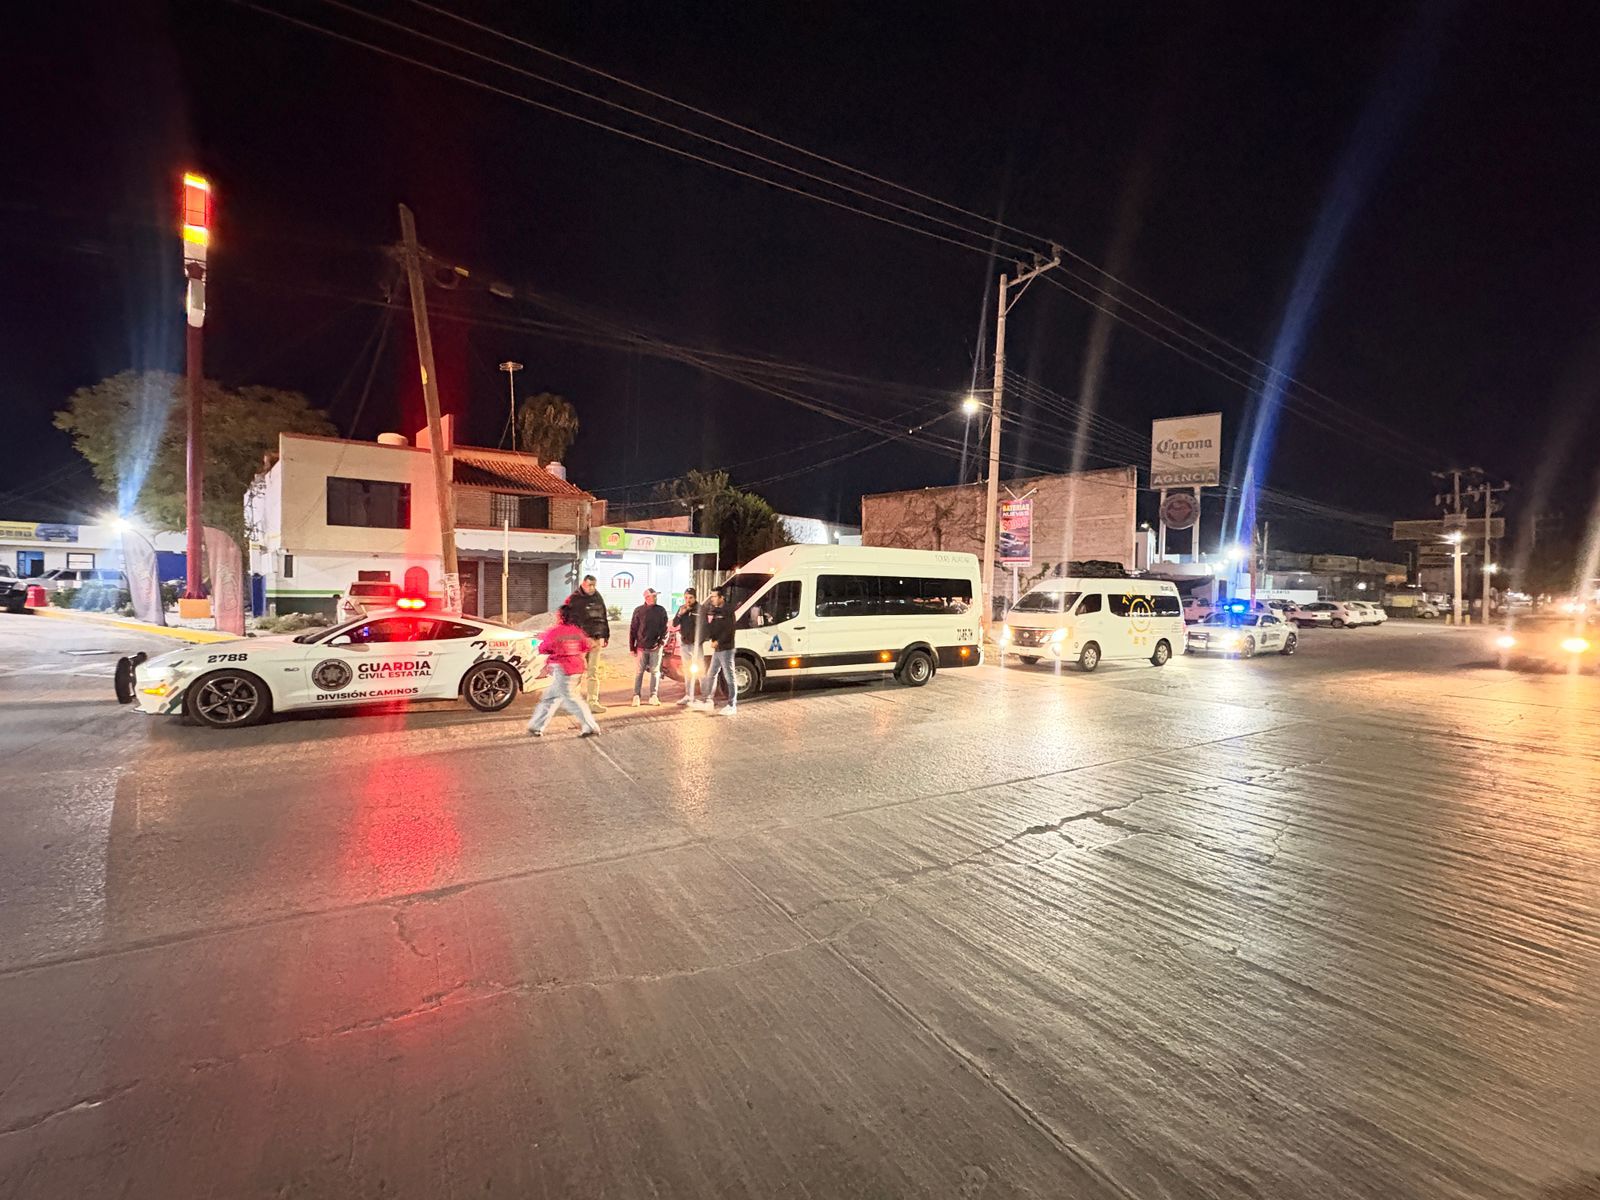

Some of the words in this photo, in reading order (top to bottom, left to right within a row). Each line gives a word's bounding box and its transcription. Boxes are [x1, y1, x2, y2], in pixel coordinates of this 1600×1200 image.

[1156, 438, 1213, 454] Corona
[1172, 451, 1200, 460] Extra
[1153, 472, 1216, 485] AGENCIA
[611, 578, 631, 589] LTH
[207, 653, 248, 664] 2788
[358, 660, 431, 673] GUARDIA
[358, 671, 386, 680] CIVIL
[388, 669, 432, 679] ESTATAL
[316, 689, 367, 701] DIVISIÓN
[369, 687, 419, 697] CAMINOS
